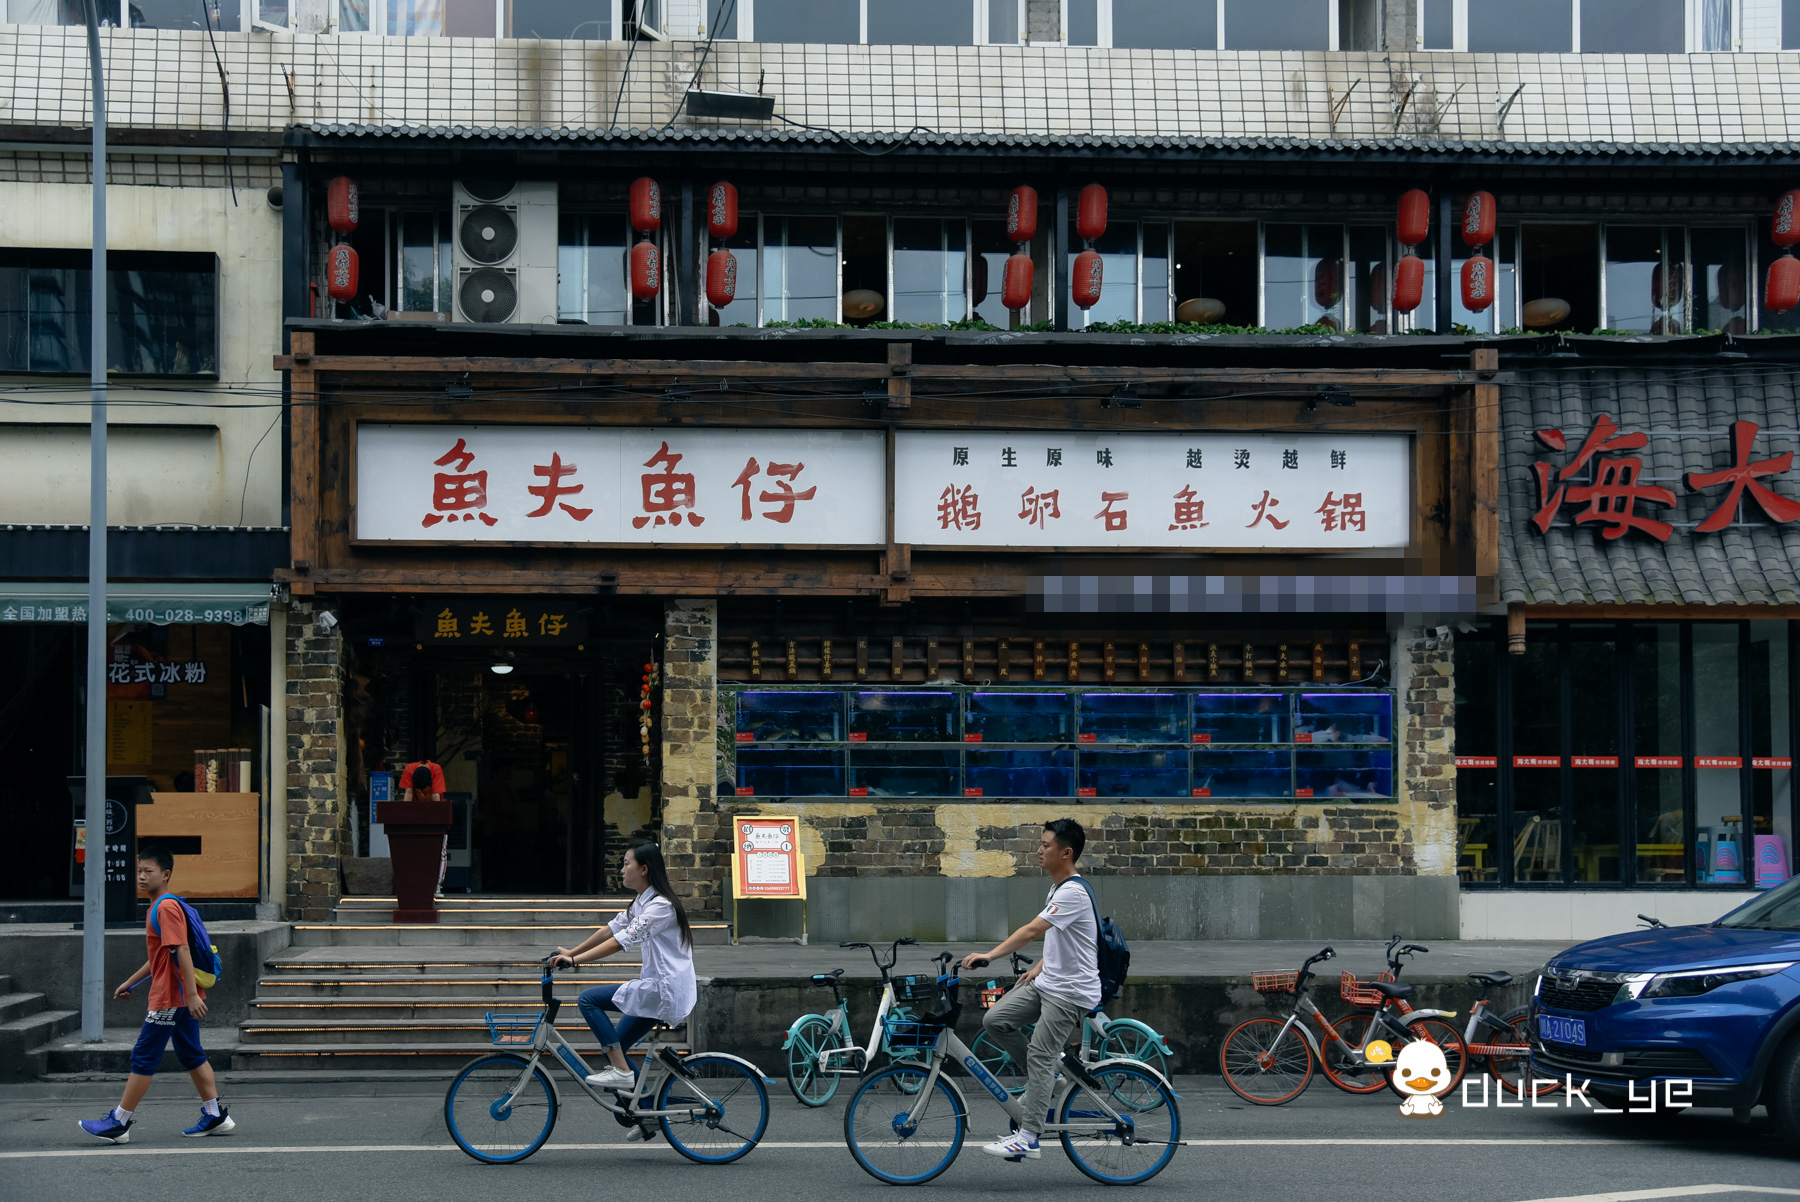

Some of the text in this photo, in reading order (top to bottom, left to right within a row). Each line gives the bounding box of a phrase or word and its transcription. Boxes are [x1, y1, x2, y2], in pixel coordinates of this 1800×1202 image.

[951, 446, 1347, 470] 原生原味 越烫越鲜
[421, 437, 818, 529] 魚夫魚仔
[1528, 413, 1800, 542] 海大
[936, 483, 1368, 533] 鹅卵石魚火锅
[2, 604, 112, 622] 全国加盟热:
[124, 607, 244, 623] 400-028-9398
[433, 607, 569, 639] 魚夫魚仔
[108, 661, 207, 684] 花式冰粉
